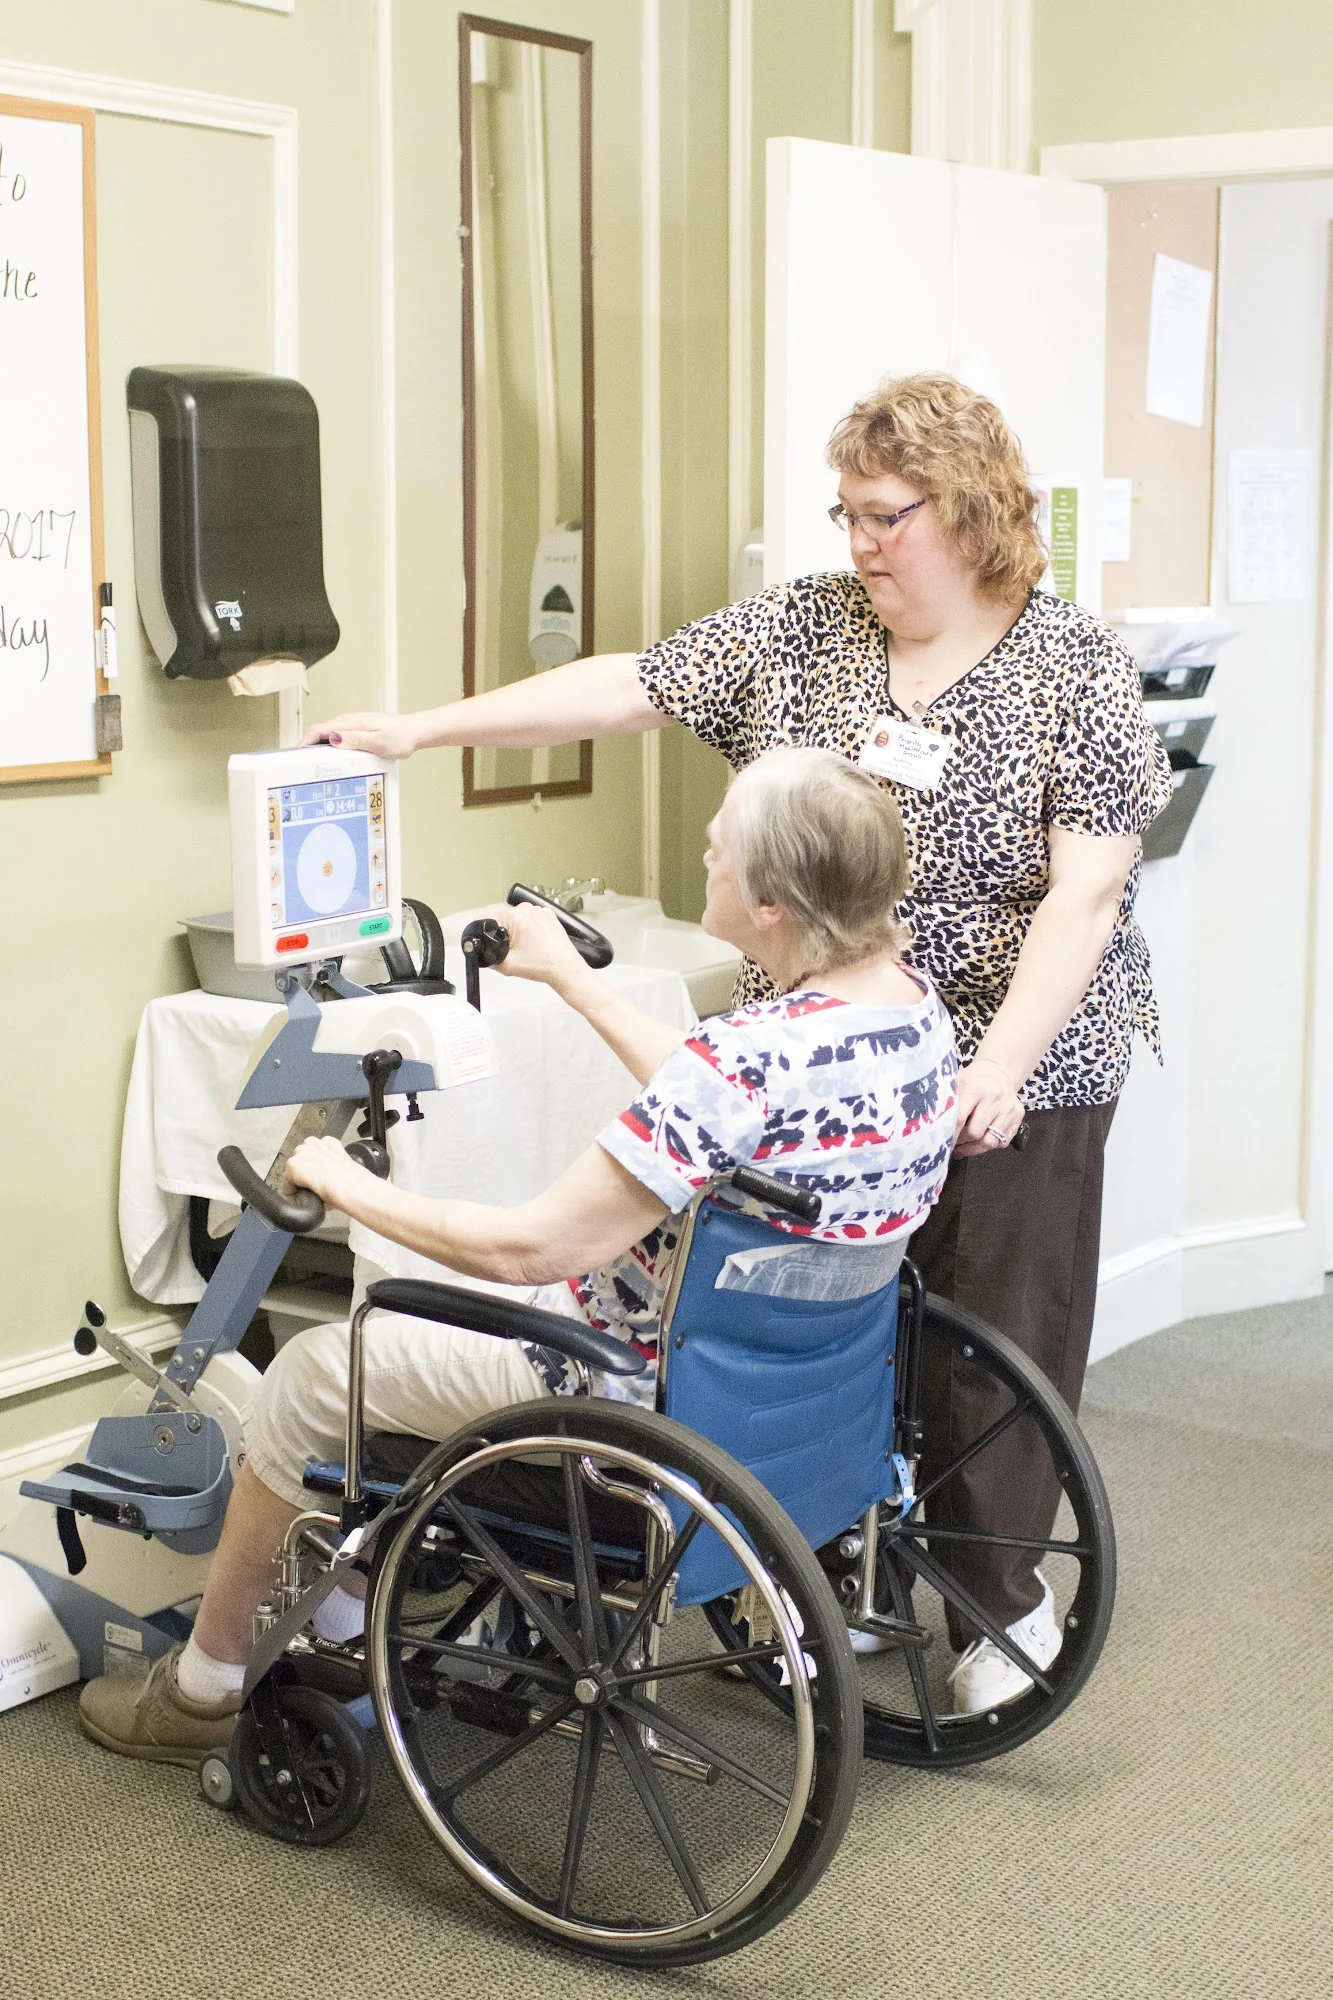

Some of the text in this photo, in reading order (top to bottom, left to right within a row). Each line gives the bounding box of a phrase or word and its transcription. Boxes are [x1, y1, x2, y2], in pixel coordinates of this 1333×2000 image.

[0, 258, 38, 301] he
[0, 508, 76, 570] 2017
[217, 606, 239, 617] TORK
[369, 791, 383, 809] 28
[268, 806, 276, 824] 3
[368, 922, 384, 931] START
[315, 1637, 341, 1650] Tracer
[0, 1640, 49, 1669] Omnicycle
